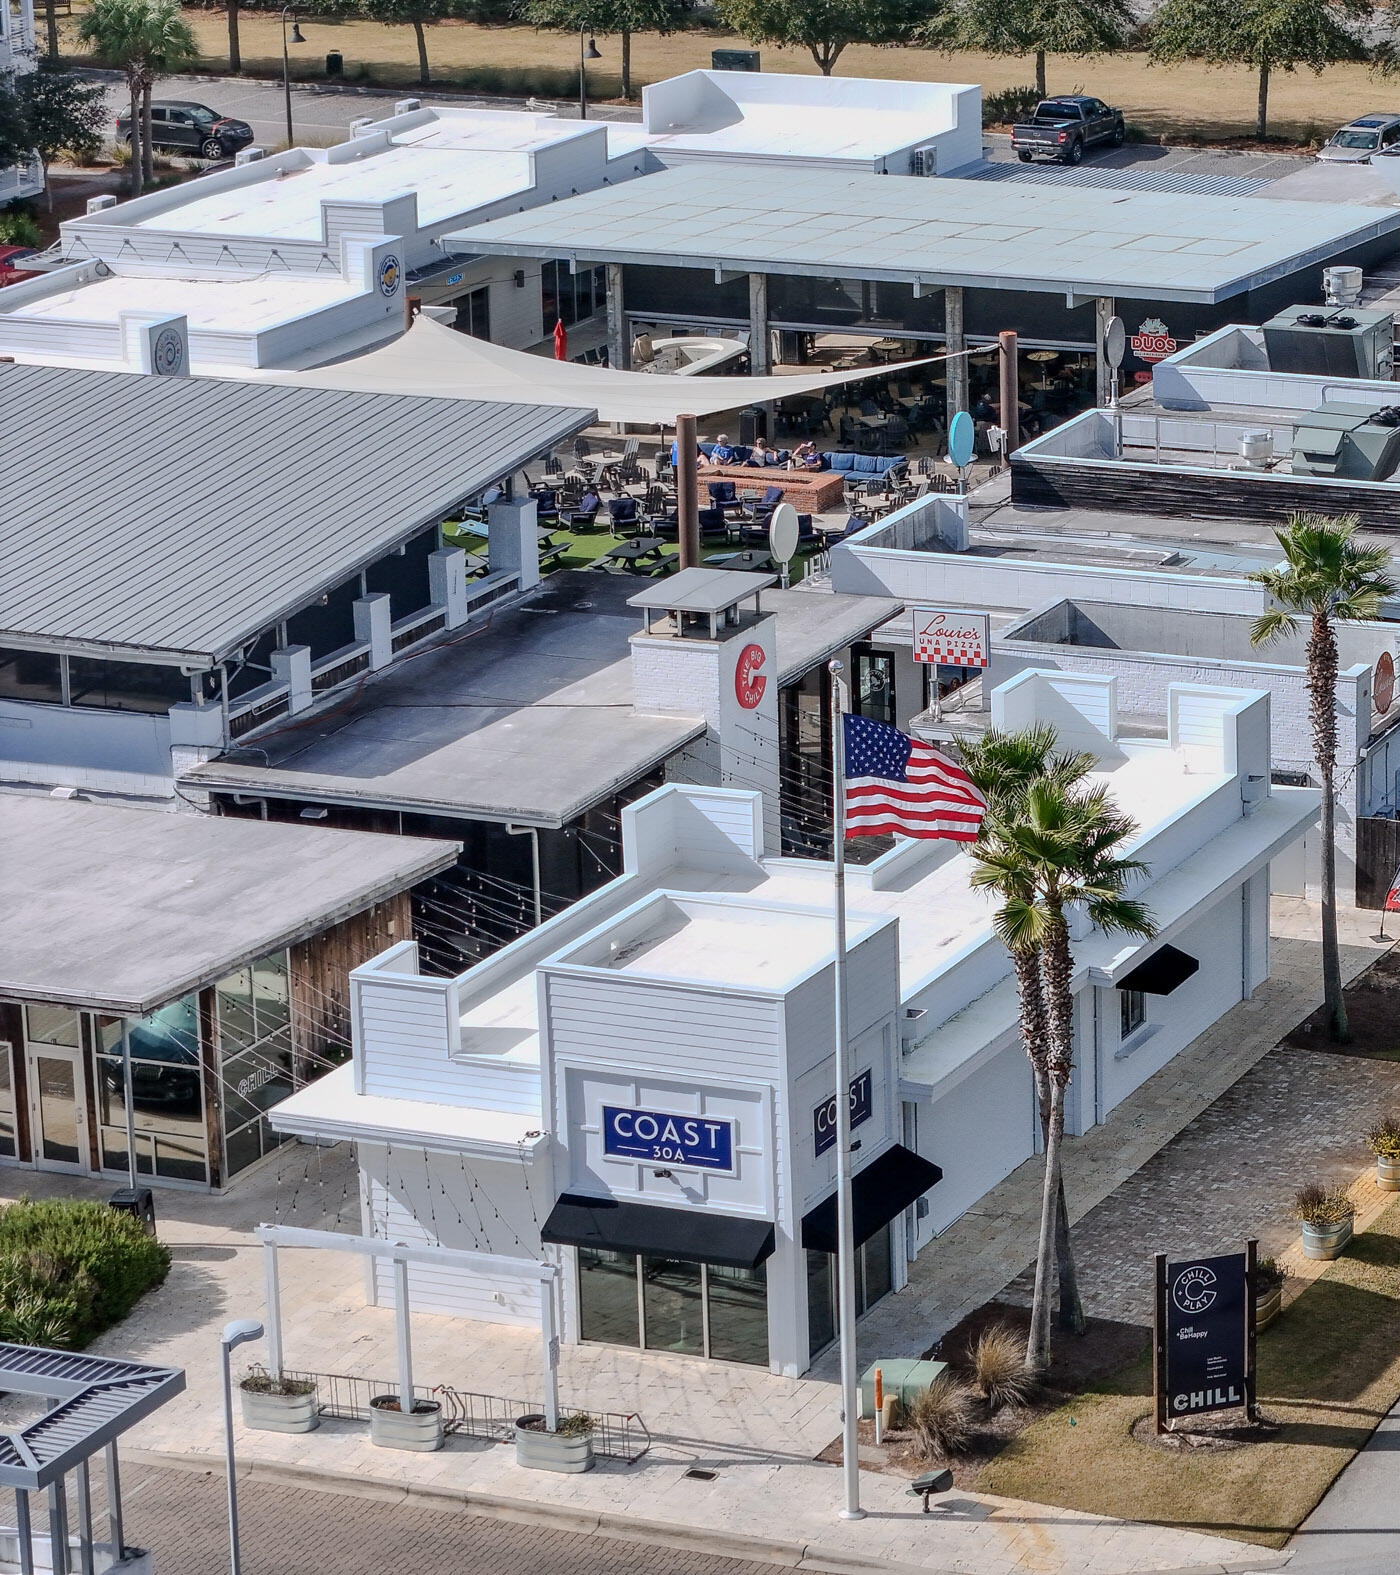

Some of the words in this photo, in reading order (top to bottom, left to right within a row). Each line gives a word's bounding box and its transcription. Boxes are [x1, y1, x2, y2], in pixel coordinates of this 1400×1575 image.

[1131, 336, 1177, 352] DUOS
[919, 614, 981, 640] Louie's
[919, 638, 941, 646] UNA
[946, 641, 982, 650] PIZZA
[742, 659, 751, 687] THE
[750, 650, 762, 663] BIG
[745, 686, 763, 704] CHILL
[238, 1062, 278, 1098] CHILL
[817, 1077, 867, 1132] COST
[613, 1112, 721, 1149] COAST
[652, 1145, 685, 1161] 30A
[1181, 1269, 1210, 1285] CHILL
[1183, 1296, 1208, 1310] PLAY
[1173, 1385, 1240, 1411] CHILL
